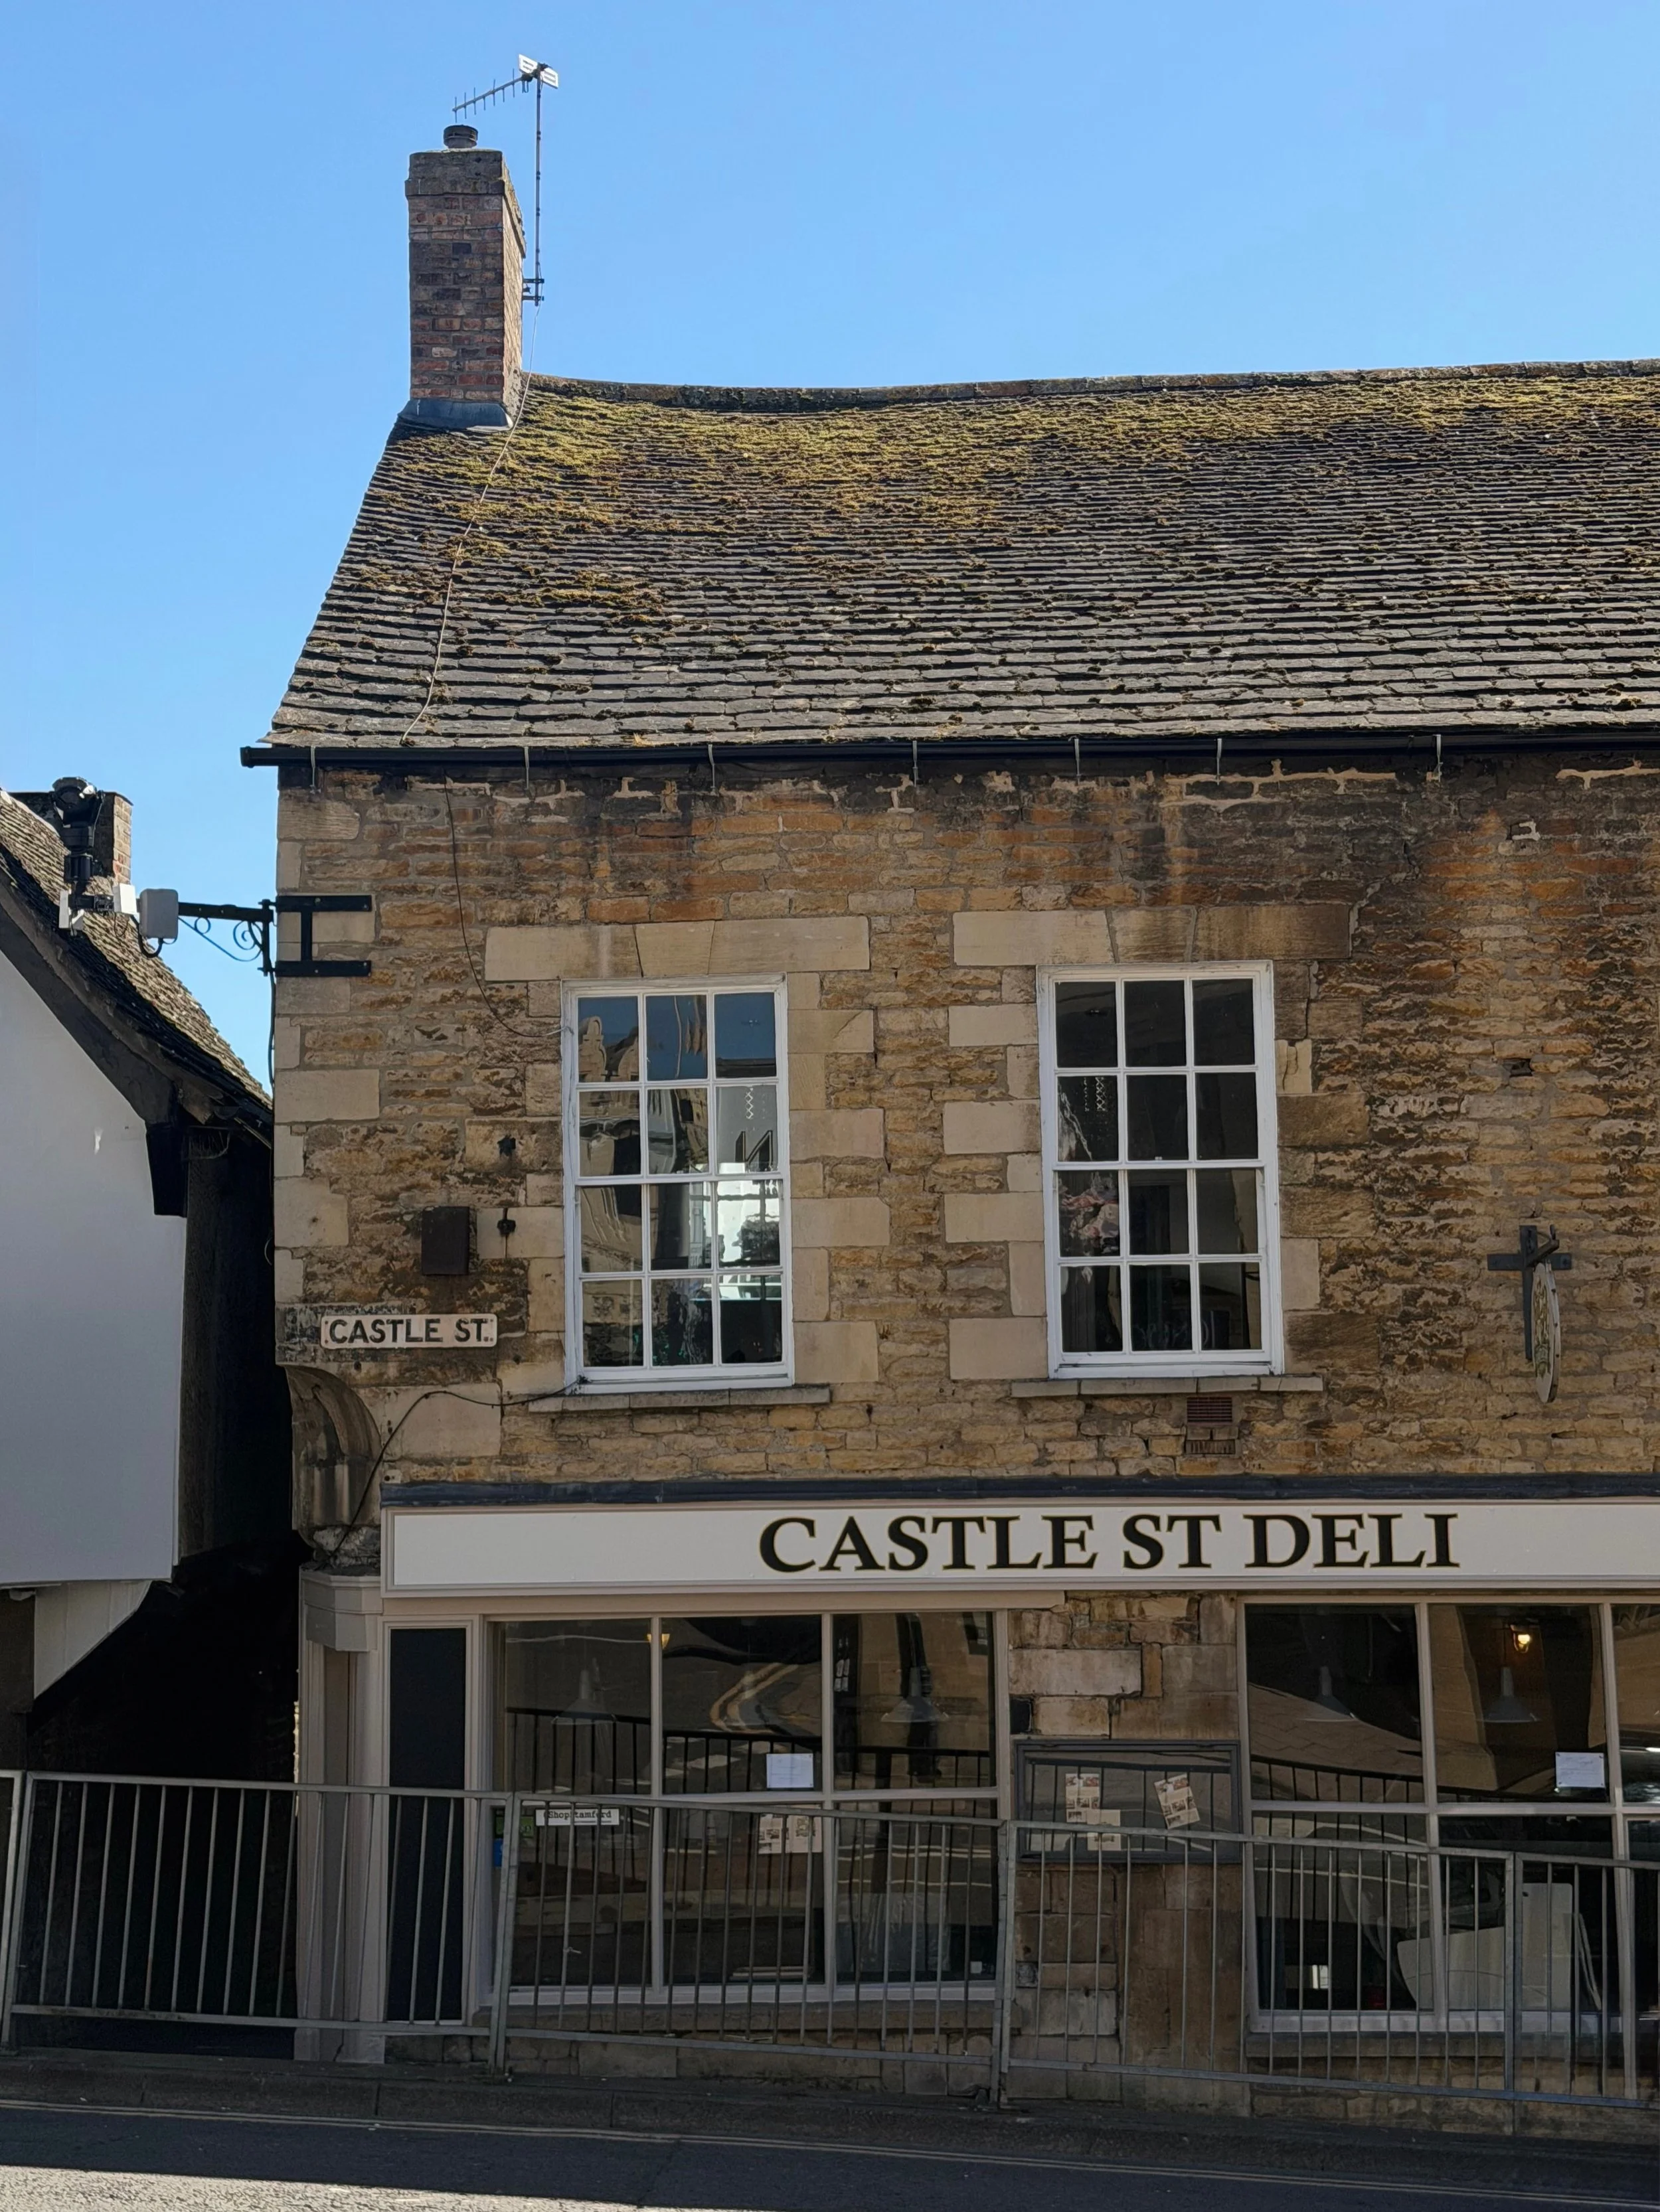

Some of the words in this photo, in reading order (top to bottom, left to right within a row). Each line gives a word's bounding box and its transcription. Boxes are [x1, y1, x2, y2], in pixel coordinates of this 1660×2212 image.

[329, 1318, 444, 1344] CASTLE
[455, 1318, 489, 1342] ST.
[759, 1514, 1099, 1573] CASTLE
[1122, 1514, 1222, 1569] ST
[1242, 1512, 1461, 1569] DELI
